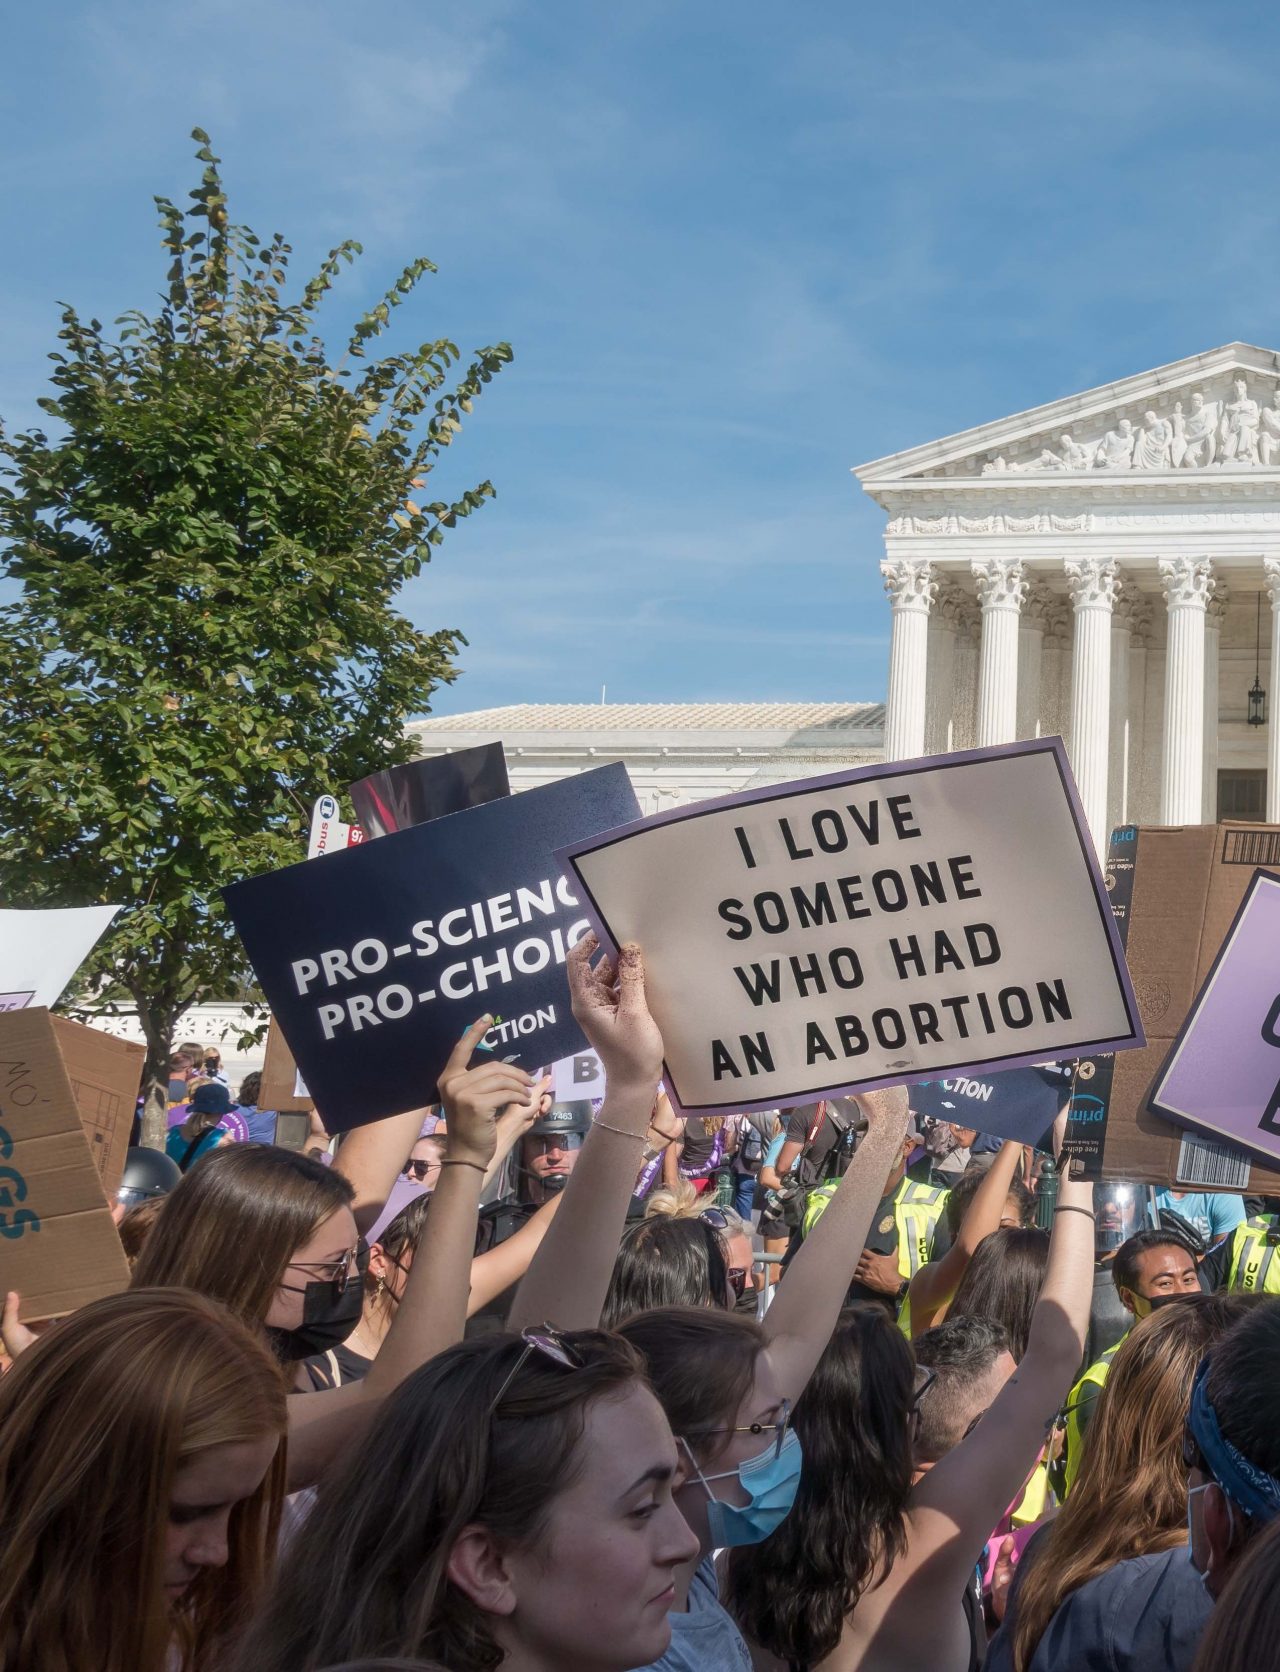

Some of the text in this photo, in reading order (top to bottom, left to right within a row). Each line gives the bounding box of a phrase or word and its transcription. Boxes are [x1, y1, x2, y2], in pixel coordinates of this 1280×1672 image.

[1106, 512, 1168, 527] EQUAL
[1181, 511, 1252, 525] JUSTICE
[734, 795, 921, 868] I LOVE
[292, 875, 579, 995] PRO-SCIENC
[717, 856, 981, 940] SOMEONE
[318, 919, 591, 1040] PRO-CHOIC
[734, 923, 1001, 1007] WHO HAD
[480, 1004, 557, 1049] CTION
[711, 1032, 775, 1081] AN
[806, 979, 1072, 1065] ABORTION
[552, 1111, 573, 1121] 7463
[943, 1077, 994, 1102] CTION
